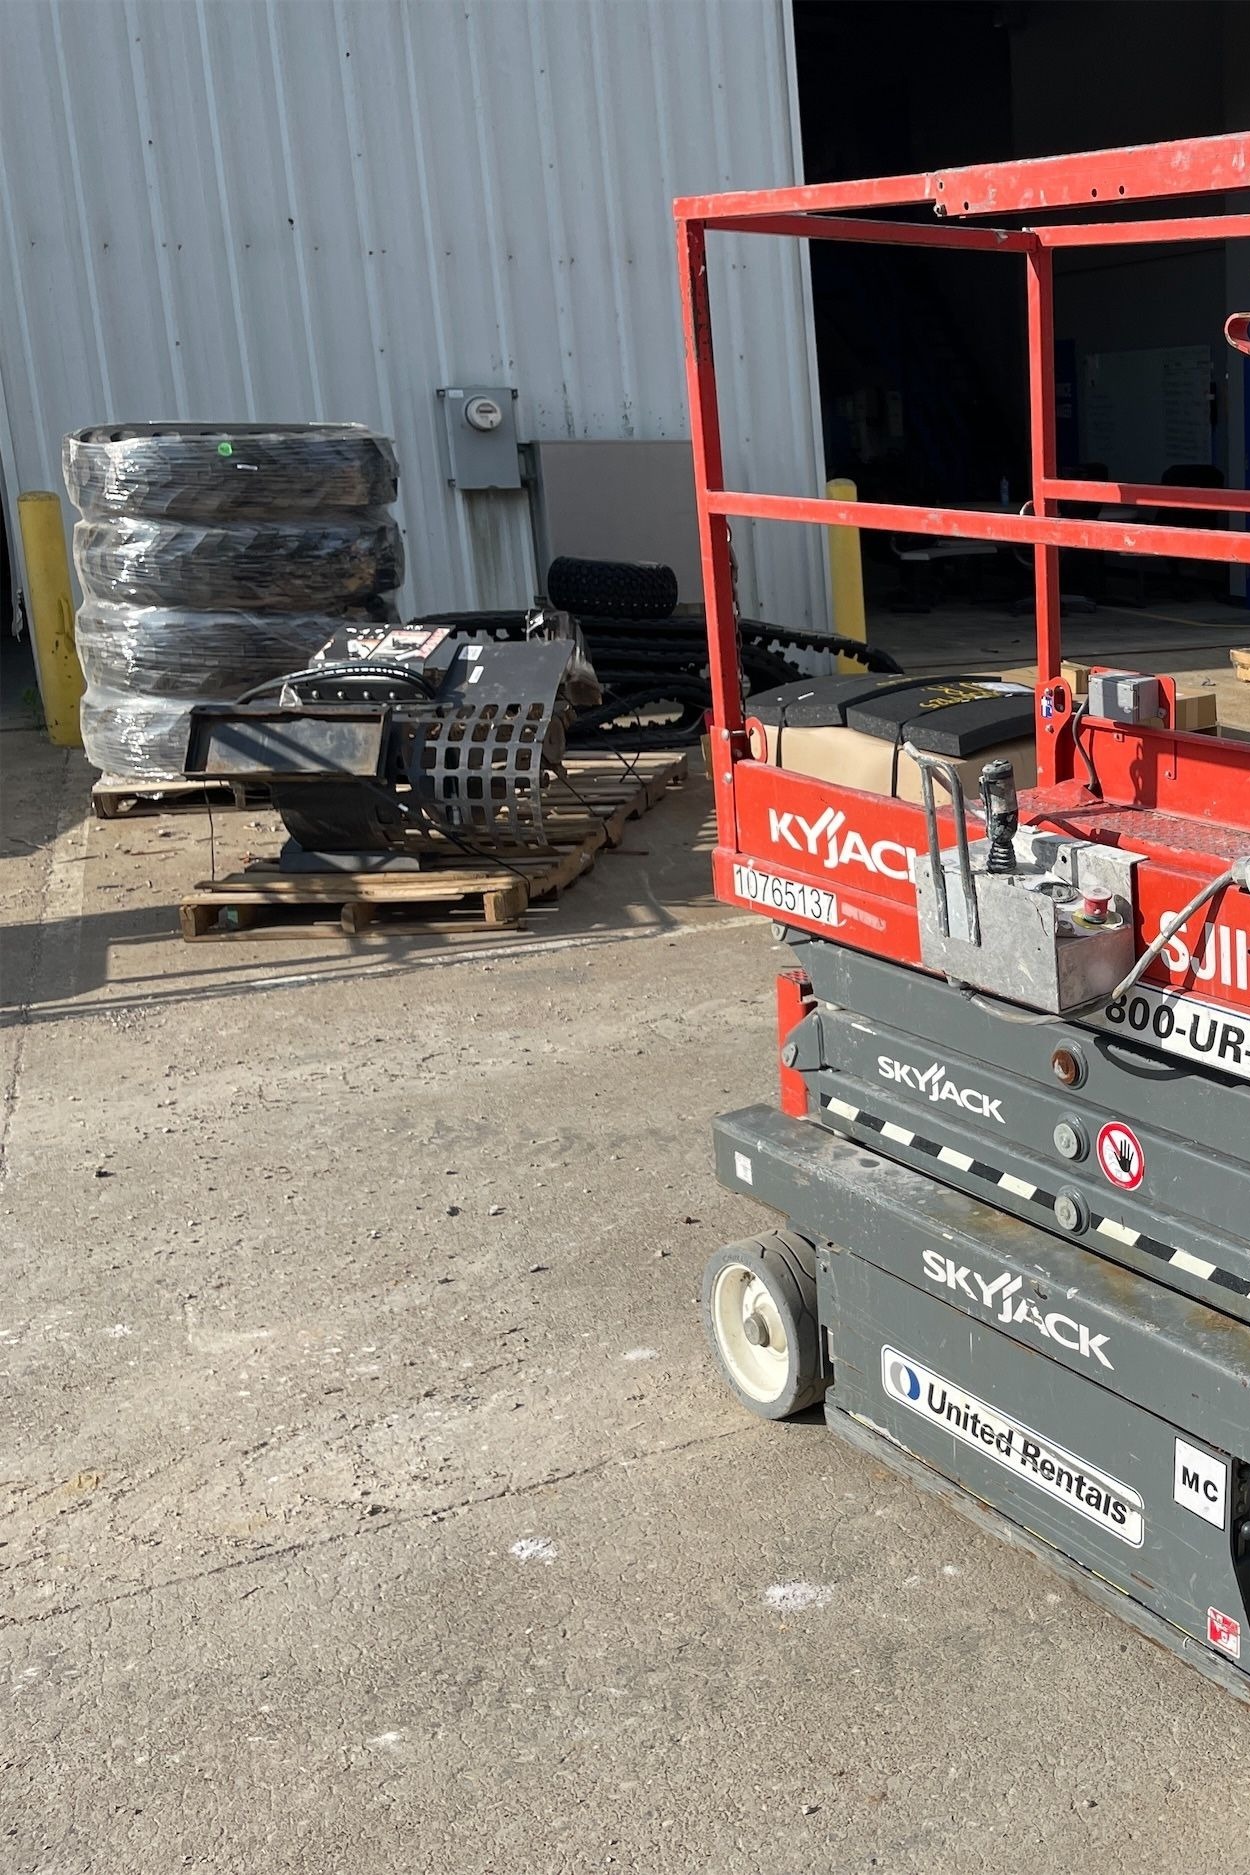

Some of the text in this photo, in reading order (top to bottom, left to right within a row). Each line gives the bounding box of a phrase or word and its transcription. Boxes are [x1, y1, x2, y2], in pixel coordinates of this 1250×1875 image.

[736, 866, 835, 925] 10765137
[877, 1055, 1006, 1124] SKYJACK
[922, 1249, 1116, 1371] SKYJACK
[927, 1382, 1128, 1526] United Rentals
[1181, 1465, 1219, 1503] MC
